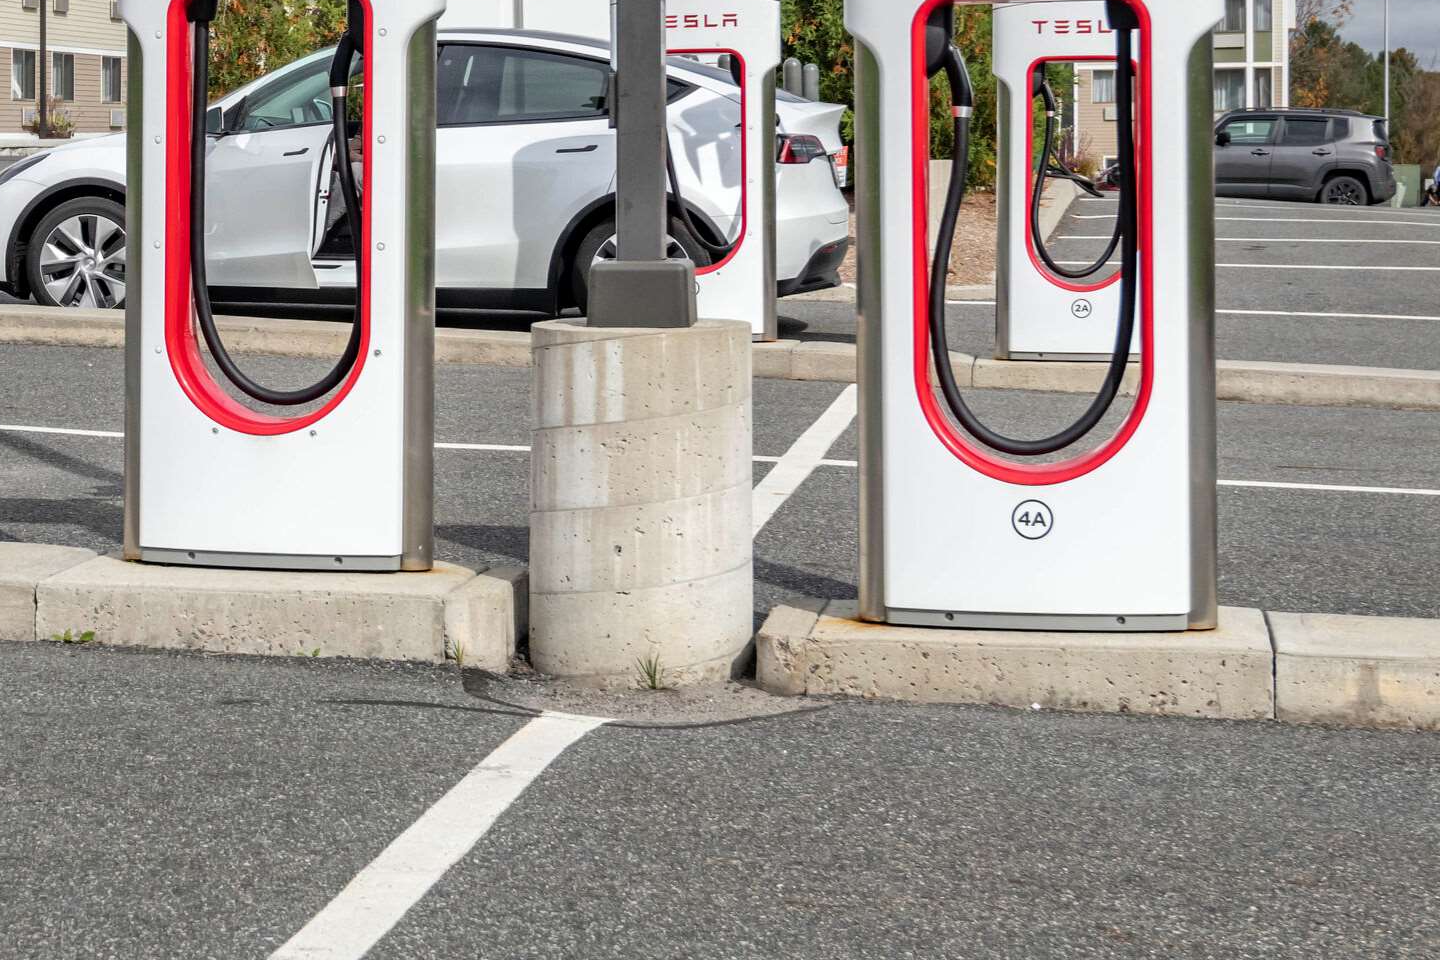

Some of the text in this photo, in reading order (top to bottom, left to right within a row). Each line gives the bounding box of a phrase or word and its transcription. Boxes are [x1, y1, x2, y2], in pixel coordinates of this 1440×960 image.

[665, 13, 738, 29] ESLA
[1031, 19, 1113, 34] TESL
[1074, 304, 1089, 312] 2A
[1017, 511, 1047, 527] 4A
